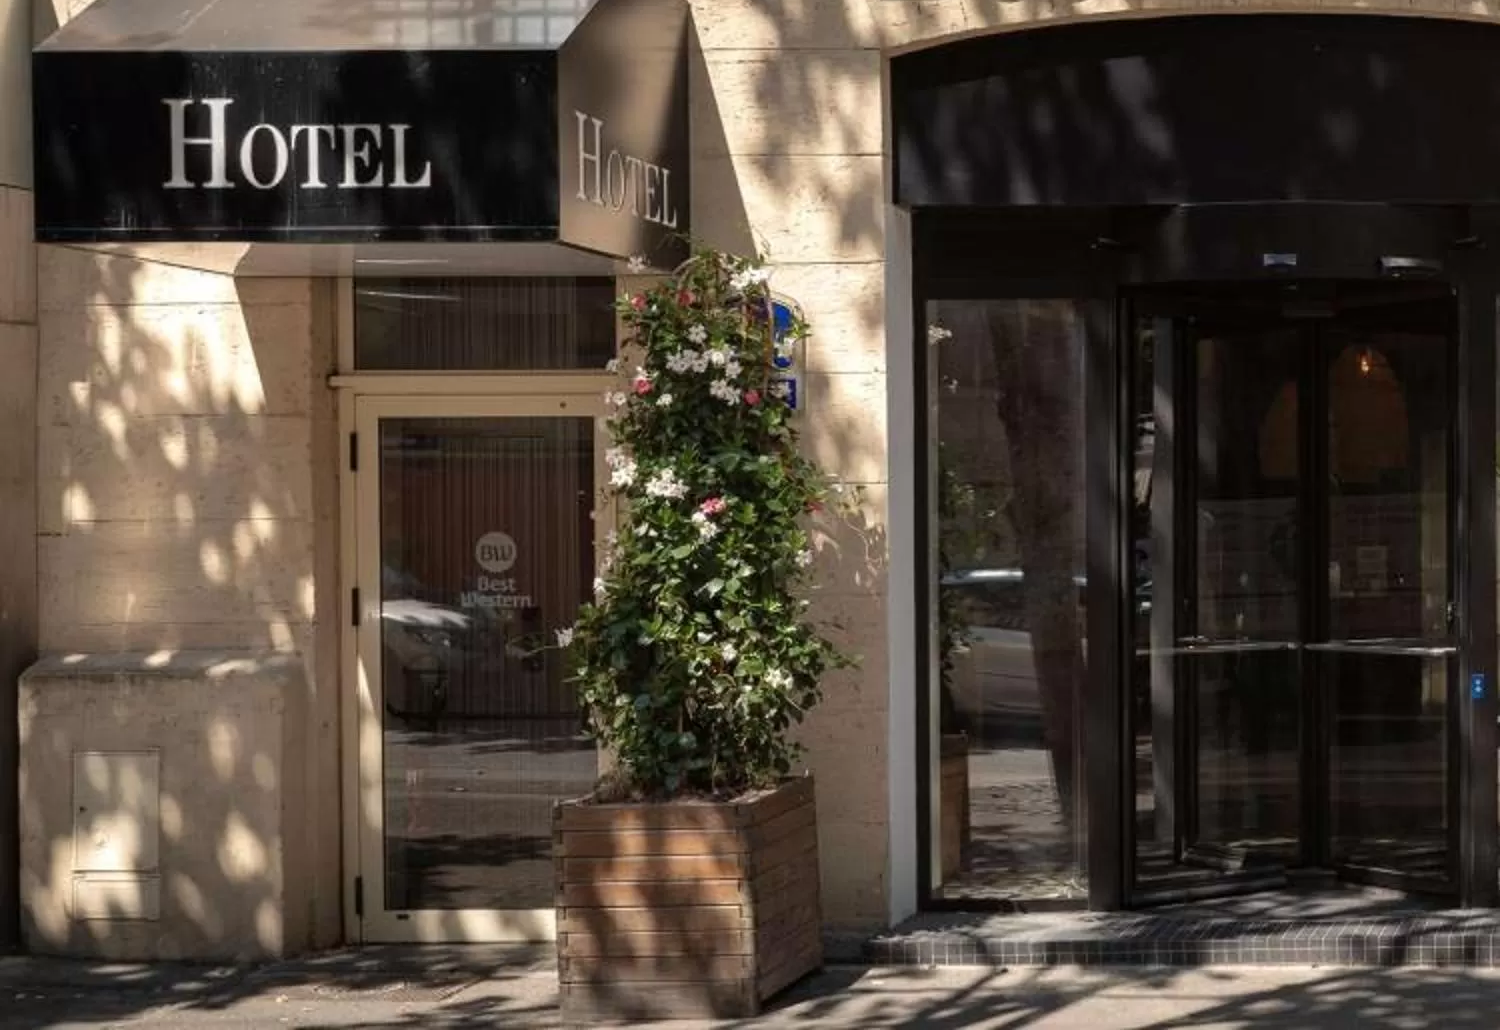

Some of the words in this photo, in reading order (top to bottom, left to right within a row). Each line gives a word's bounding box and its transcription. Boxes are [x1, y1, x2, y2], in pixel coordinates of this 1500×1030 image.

[162, 96, 433, 190] HOTEL
[574, 108, 678, 230] HOTEL
[460, 591, 533, 609] Western
[477, 575, 517, 592] Best
